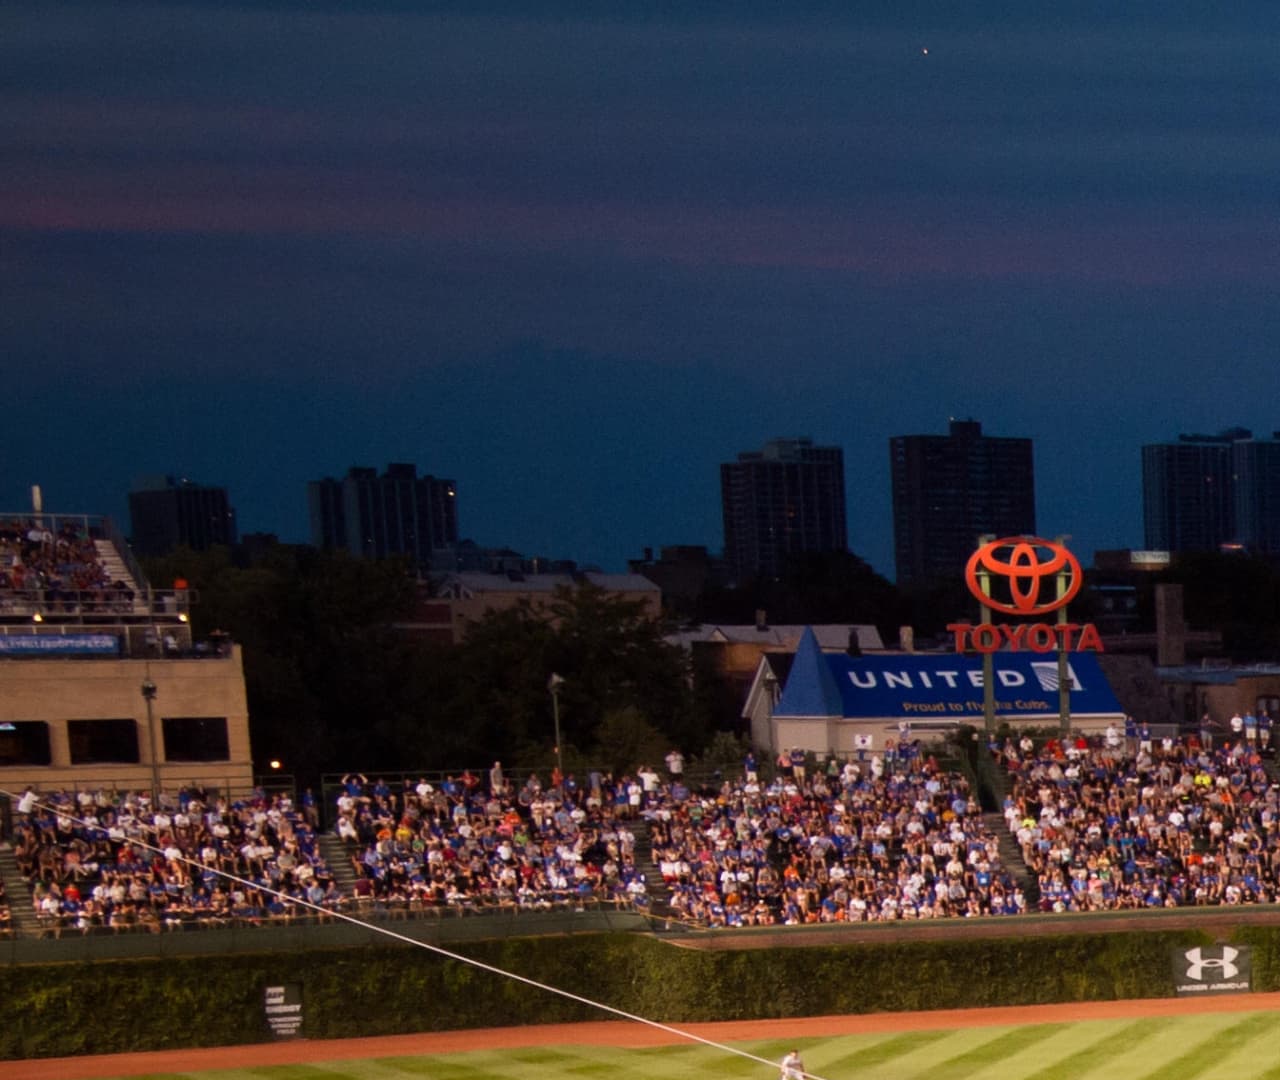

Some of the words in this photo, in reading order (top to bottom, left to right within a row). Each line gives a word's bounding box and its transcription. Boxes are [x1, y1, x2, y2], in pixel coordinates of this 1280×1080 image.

[946, 623, 1104, 653] TOYOTA
[849, 670, 1025, 688] UNITED
[903, 702, 946, 712] Proud
[950, 703, 963, 711] to
[967, 702, 985, 713] fly
[1176, 984, 1208, 992] UNDER
[1210, 982, 1248, 990] ARMOUR
